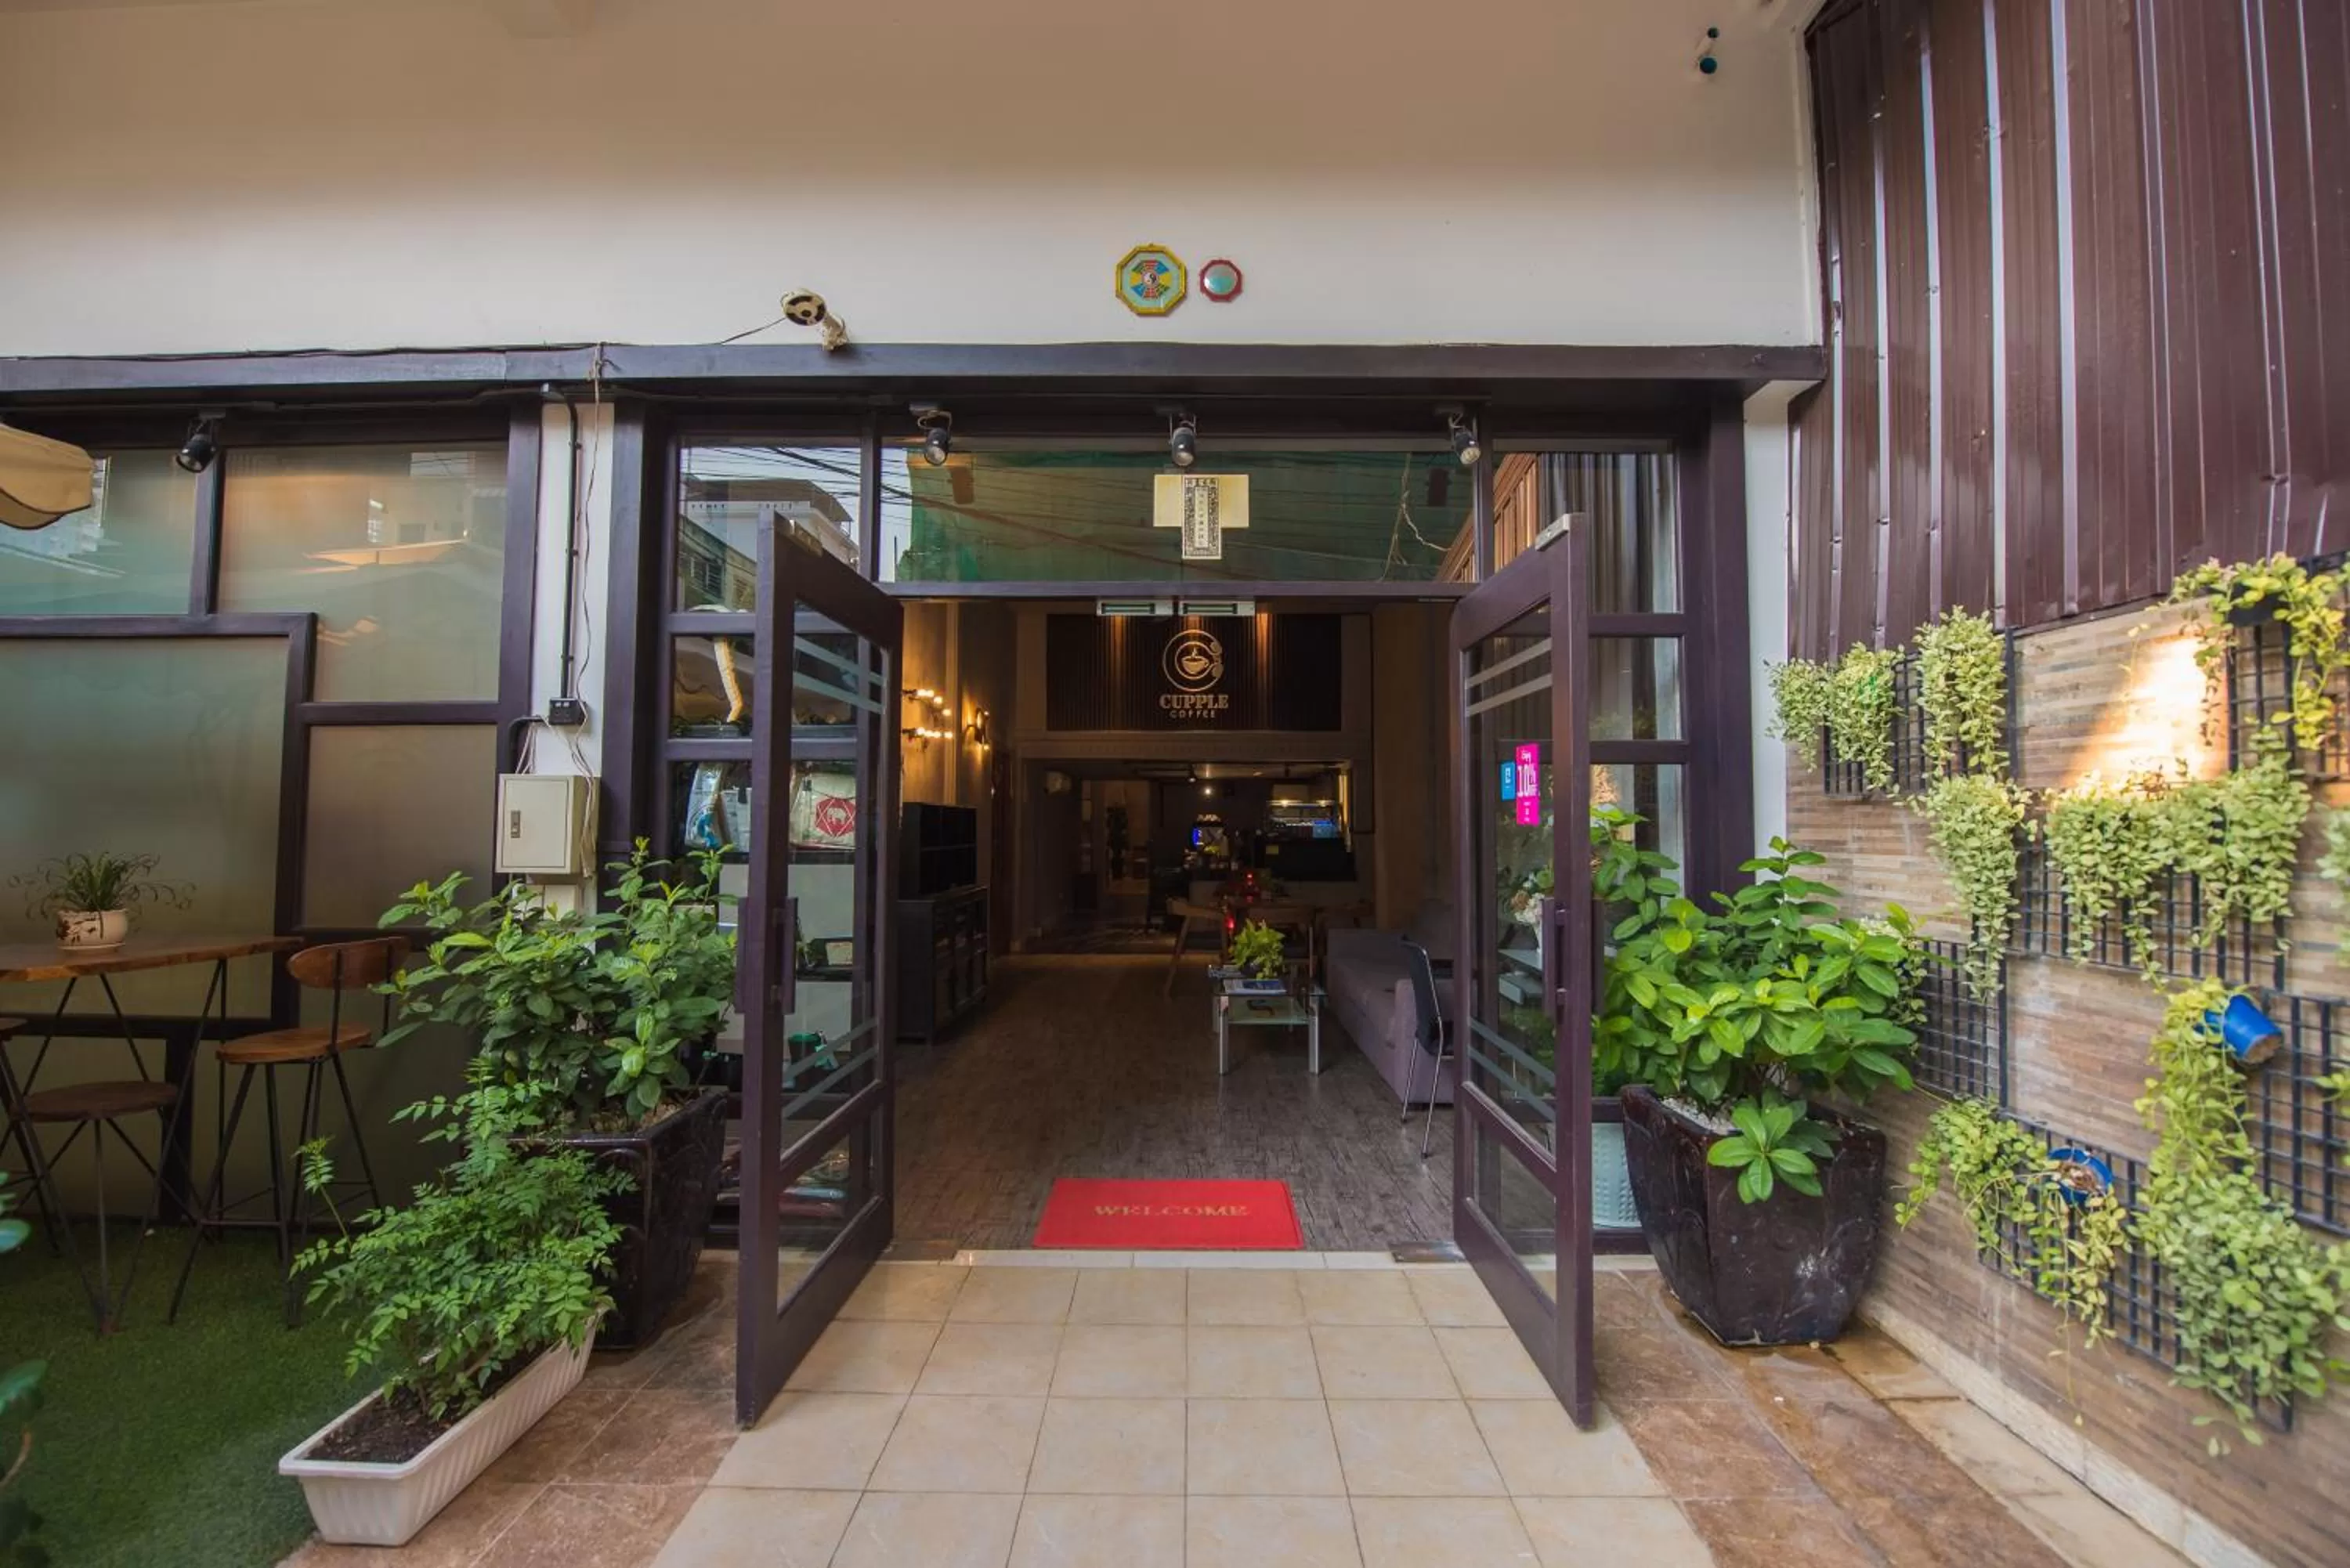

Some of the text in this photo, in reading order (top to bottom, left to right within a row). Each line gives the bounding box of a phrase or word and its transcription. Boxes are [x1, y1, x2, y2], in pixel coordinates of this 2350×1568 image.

[1159, 694, 1229, 710] CUPPLE
[1169, 710, 1216, 719] COFFEE
[1094, 1203, 1250, 1216] WELCOME
